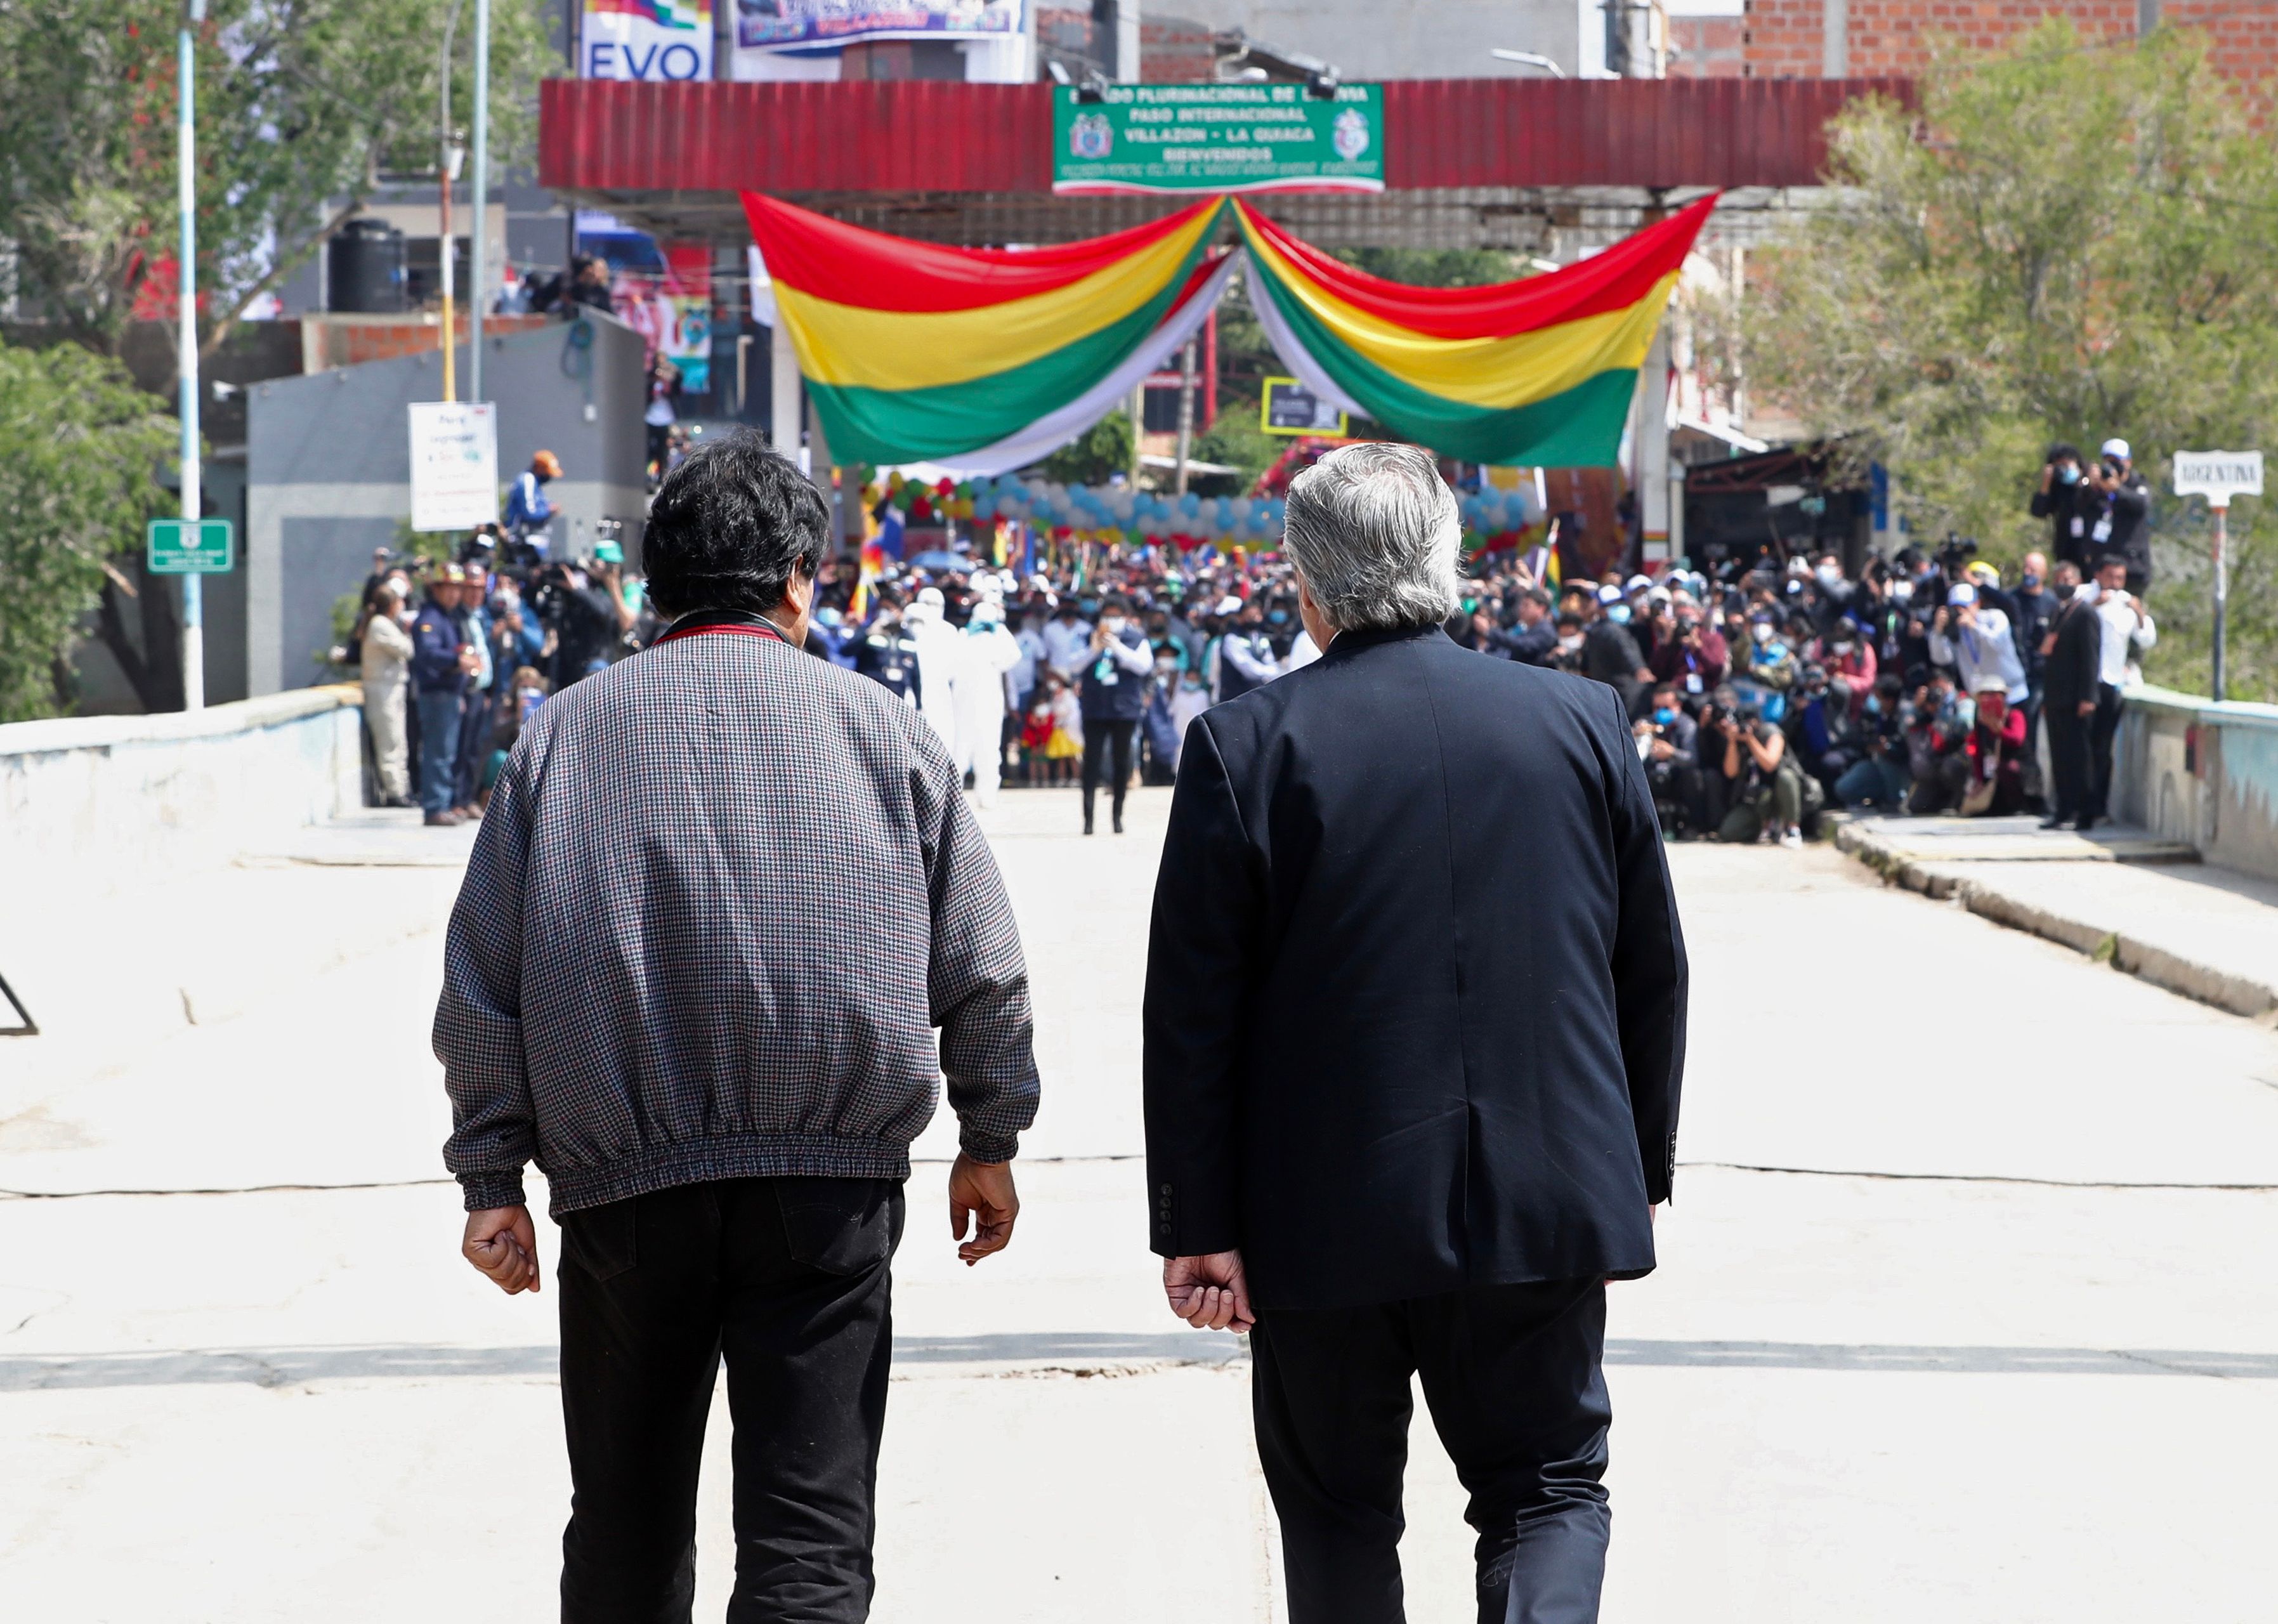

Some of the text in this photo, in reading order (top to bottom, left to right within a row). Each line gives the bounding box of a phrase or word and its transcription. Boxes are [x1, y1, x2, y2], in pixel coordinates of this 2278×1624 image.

[591, 44, 700, 79] EVO
[1136, 87, 1269, 102] PLURINACIONAL
[1272, 87, 1295, 102] DE
[1129, 107, 1307, 122] PASO INTERNACIONAL
[1226, 128, 1250, 142] LA
[1253, 128, 1315, 142] QUIACA
[1163, 147, 1273, 162] BIENVENIDOS
